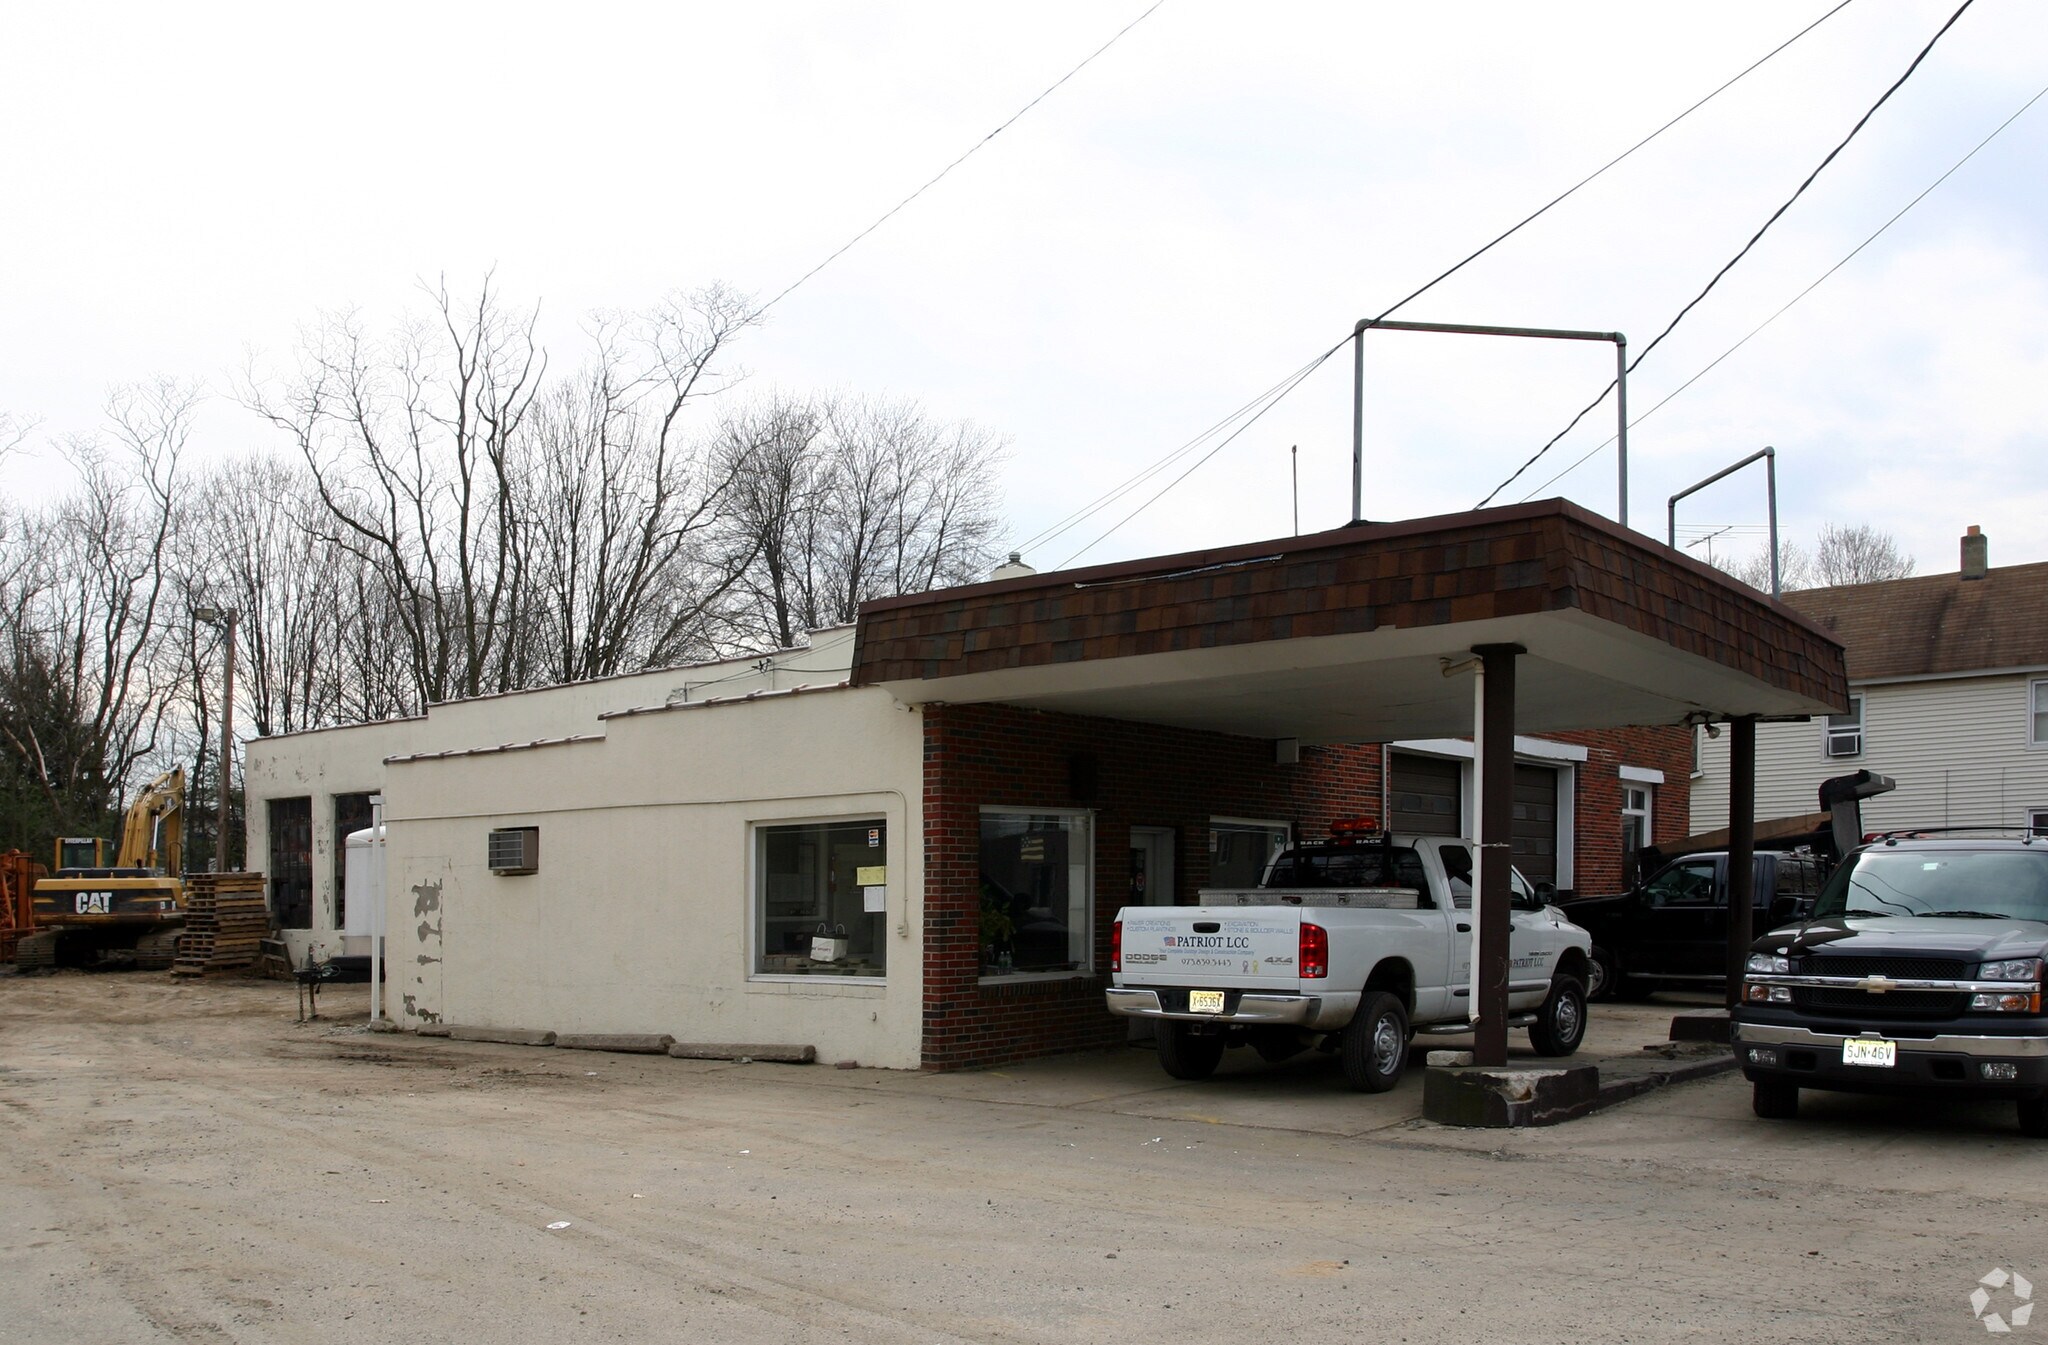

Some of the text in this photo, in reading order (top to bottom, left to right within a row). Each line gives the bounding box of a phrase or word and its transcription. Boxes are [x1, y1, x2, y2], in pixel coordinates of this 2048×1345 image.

[75, 892, 112, 914] CAT
[1177, 936, 1250, 948] PATRIOT LCC
